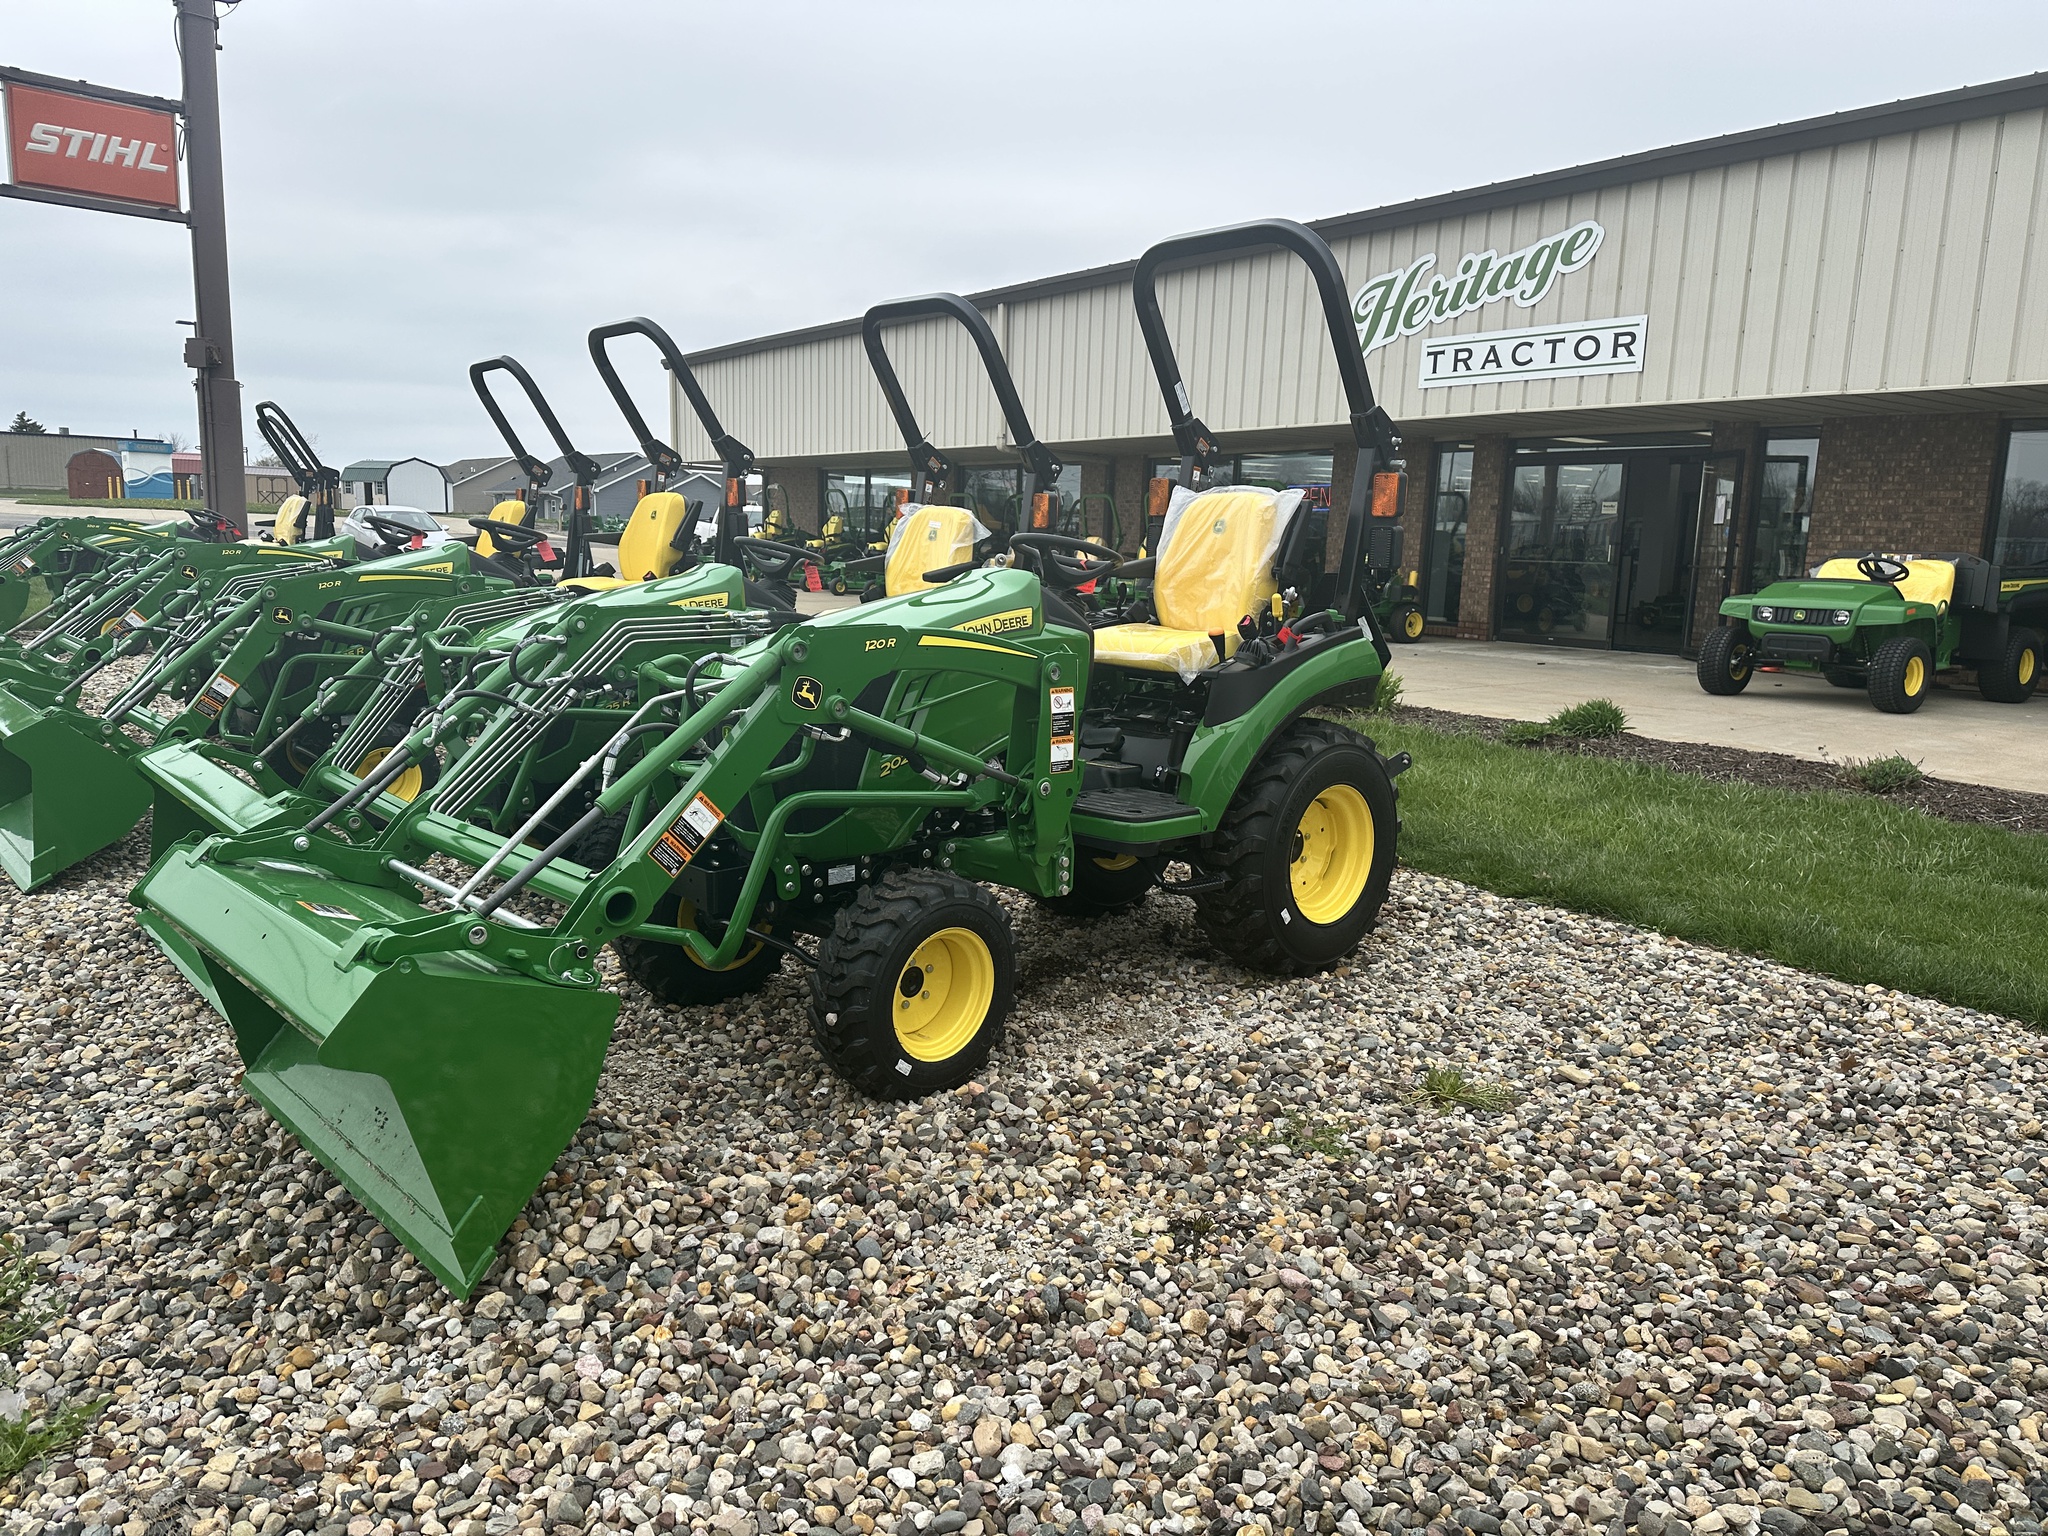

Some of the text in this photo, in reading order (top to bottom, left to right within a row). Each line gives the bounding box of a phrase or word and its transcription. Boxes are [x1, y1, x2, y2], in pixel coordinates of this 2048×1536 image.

[24, 122, 169, 173] STIHL
[1354, 227, 1600, 352] Heritage
[1426, 331, 1637, 375] TRACTOR
[1302, 487, 1332, 507] PEN
[318, 581, 333, 590] 120
[963, 615, 1029, 635] JOHN DEERE
[864, 638, 897, 652] 120 R
[703, 799, 721, 818] WARNING
[669, 840, 688, 858] WARNING
